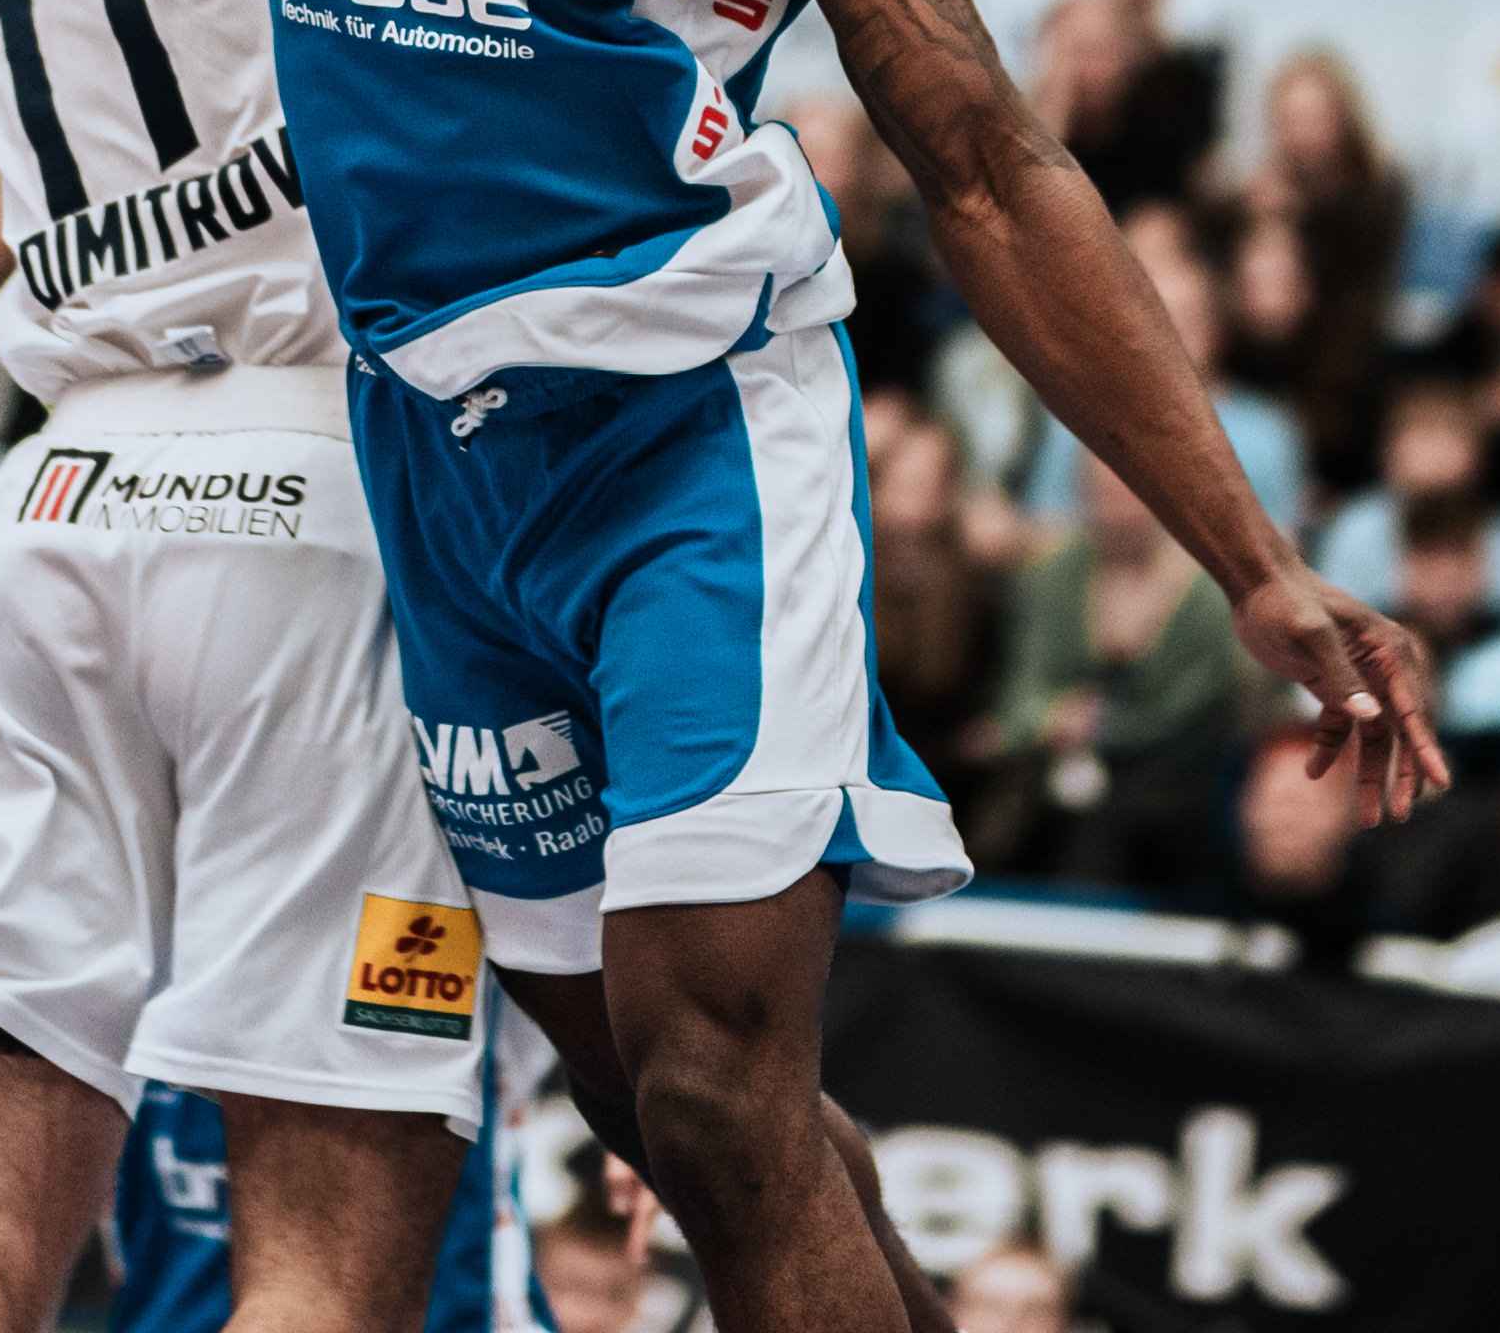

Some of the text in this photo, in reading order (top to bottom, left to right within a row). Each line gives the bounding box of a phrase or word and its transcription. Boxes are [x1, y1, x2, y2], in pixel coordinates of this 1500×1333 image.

[345, 15, 375, 40] für
[381, 20, 535, 60] Automobile
[19, 125, 306, 312] DIMITROV
[101, 472, 308, 507] MUNDUS
[413, 715, 511, 796] VM
[535, 812, 605, 858] Raab
[360, 962, 465, 1003] LOTTO
